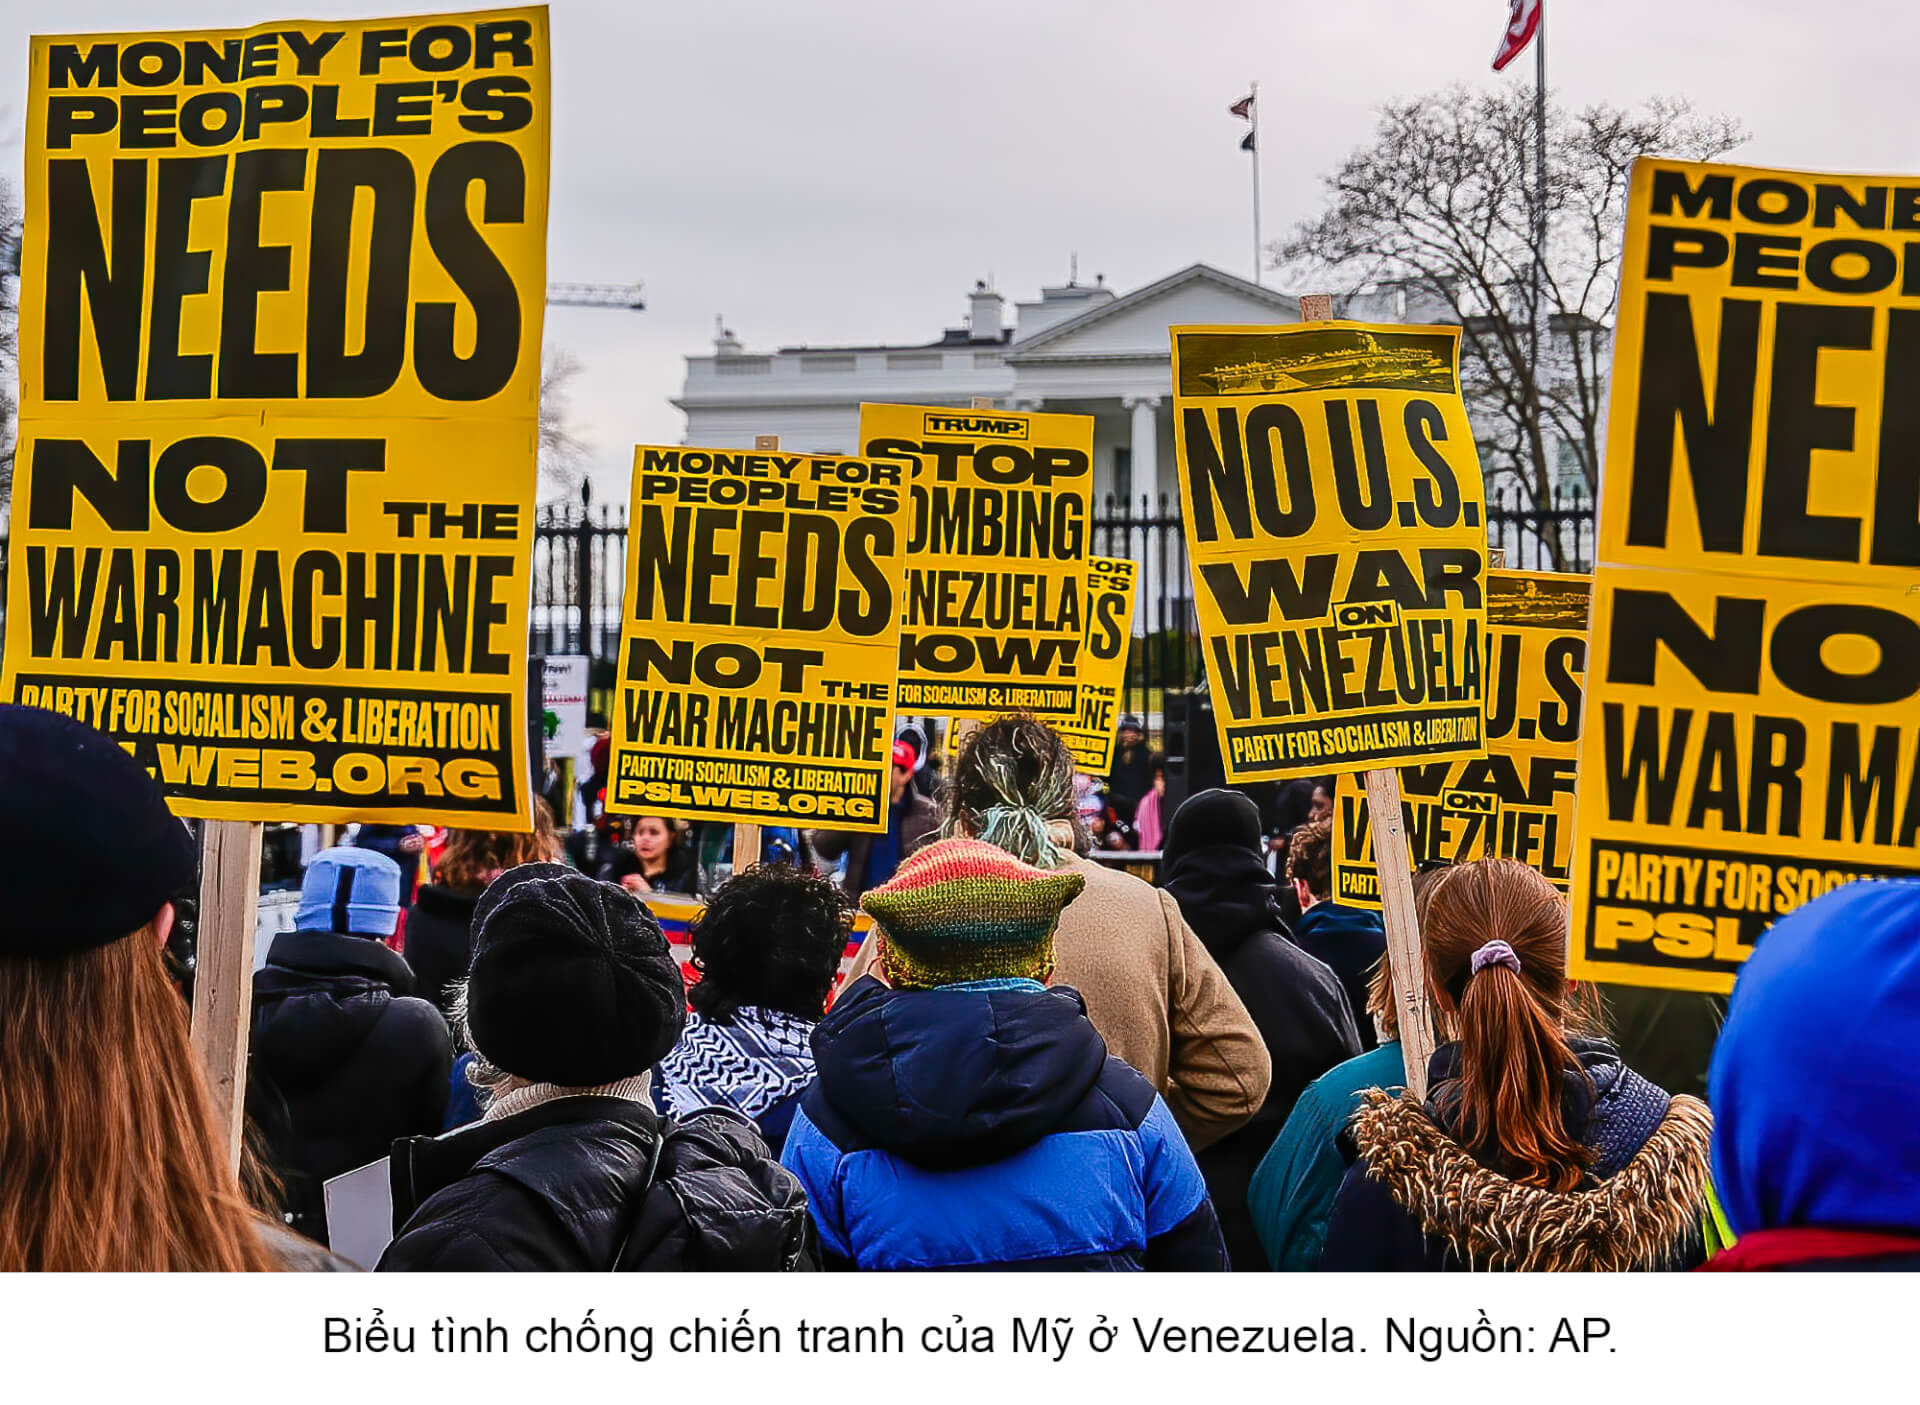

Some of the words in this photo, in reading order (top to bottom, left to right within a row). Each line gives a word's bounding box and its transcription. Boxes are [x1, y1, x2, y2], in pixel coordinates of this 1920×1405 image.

[48, 31, 345, 88] MONEY
[360, 20, 533, 75] FOR
[46, 75, 533, 149] PEOPLE'S
[43, 140, 524, 402] NEEDS
[928, 417, 1025, 436] TRUMP:
[29, 436, 386, 533] NOT
[643, 450, 802, 479] MONEY
[811, 460, 901, 486] FOR
[866, 438, 1089, 486] STOP
[1182, 403, 1316, 542] NO
[1324, 399, 1480, 531] U.S.
[383, 502, 519, 540] THE
[641, 477, 899, 515] PEOPLE'S
[907, 485, 1083, 561] OMBING
[634, 505, 895, 637] NEEDS
[1088, 559, 1133, 576] OR
[1199, 548, 1482, 625] WAR
[26, 546, 180, 662] WAR
[190, 549, 514, 675] MACHINE
[901, 568, 1081, 632] NEZUELA
[1338, 605, 1392, 627] ON
[627, 638, 824, 694] NOT
[821, 681, 889, 701] THE
[1210, 618, 1481, 720] VENEZUELA
[109, 689, 160, 733] FOR
[164, 691, 294, 740] SOCIALISM
[301, 699, 337, 742] &
[343, 700, 499, 751] LIBERATION
[624, 688, 708, 749] WAR
[715, 696, 887, 762] MACHINE
[899, 684, 921, 703] FOR
[924, 686, 986, 705] SOCIALISM
[989, 690, 1004, 706] &
[1006, 689, 1073, 709] LIBERATION
[1232, 734, 1289, 763] PARTY
[1288, 730, 1321, 759] FOR
[1322, 721, 1411, 755] SOCIALISM
[1413, 721, 1426, 746] &
[1426, 716, 1477, 745] LIBERATION
[119, 742, 501, 800] WEB.ORG
[619, 779, 875, 818] PSLWEB.ORG
[621, 755, 666, 779] PARTY
[667, 758, 695, 783] FOR
[696, 762, 770, 788] SOCIALISM
[772, 768, 791, 787] &
[793, 768, 878, 796] LIBERATION
[1602, 702, 1807, 838] WAR
[1447, 794, 1492, 811] ON
[1342, 872, 1381, 895] PART
[1596, 849, 1703, 905] PARTY
[1703, 859, 1772, 912] FOR
